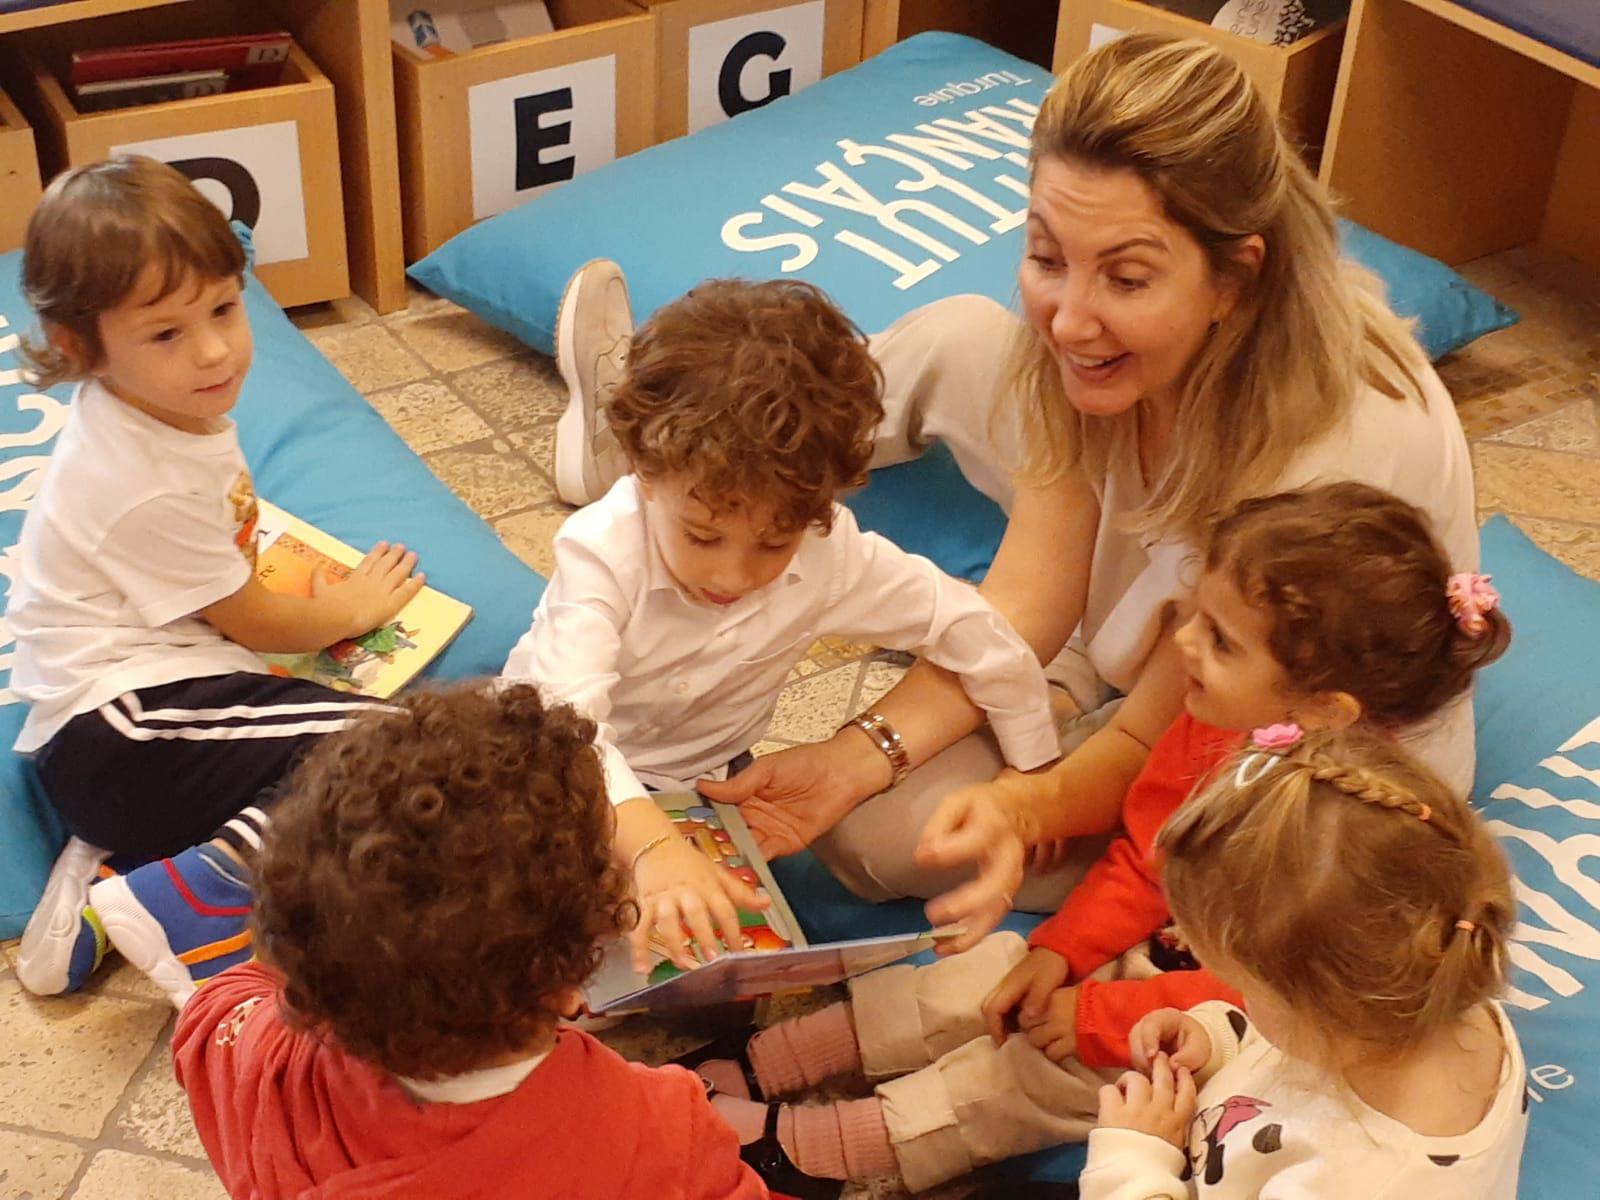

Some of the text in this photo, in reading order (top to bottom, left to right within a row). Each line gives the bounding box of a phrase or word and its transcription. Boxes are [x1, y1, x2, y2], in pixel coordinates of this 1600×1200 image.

[718, 31, 792, 118] G
[913, 70, 1033, 108] Turquie
[514, 87, 576, 191] E
